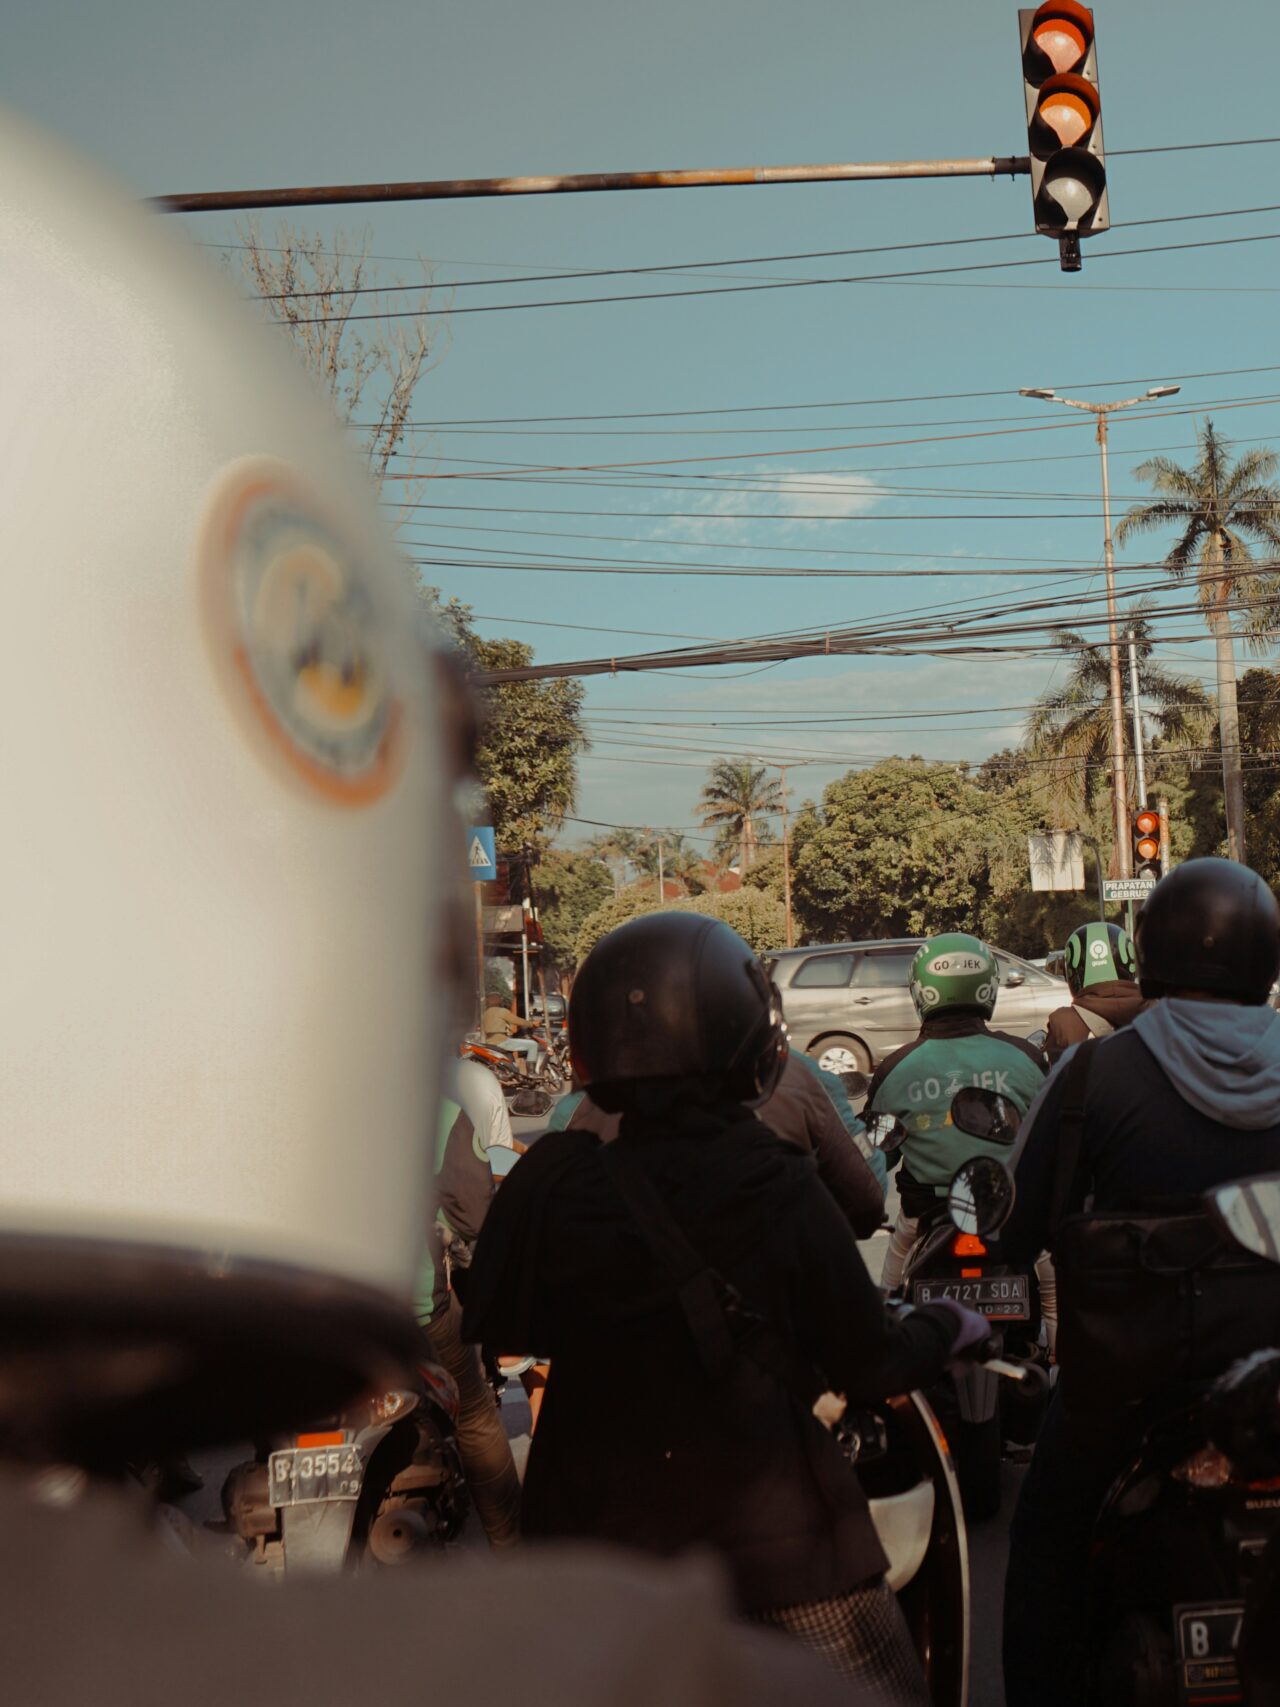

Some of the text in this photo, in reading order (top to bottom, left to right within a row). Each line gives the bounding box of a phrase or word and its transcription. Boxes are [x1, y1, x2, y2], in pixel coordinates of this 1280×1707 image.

[1105, 881, 1153, 891] PRAPATAN
[908, 1077, 941, 1103] GO
[921, 1282, 1020, 1303] B 4727 SDA
[1190, 1620, 1210, 1658] B
